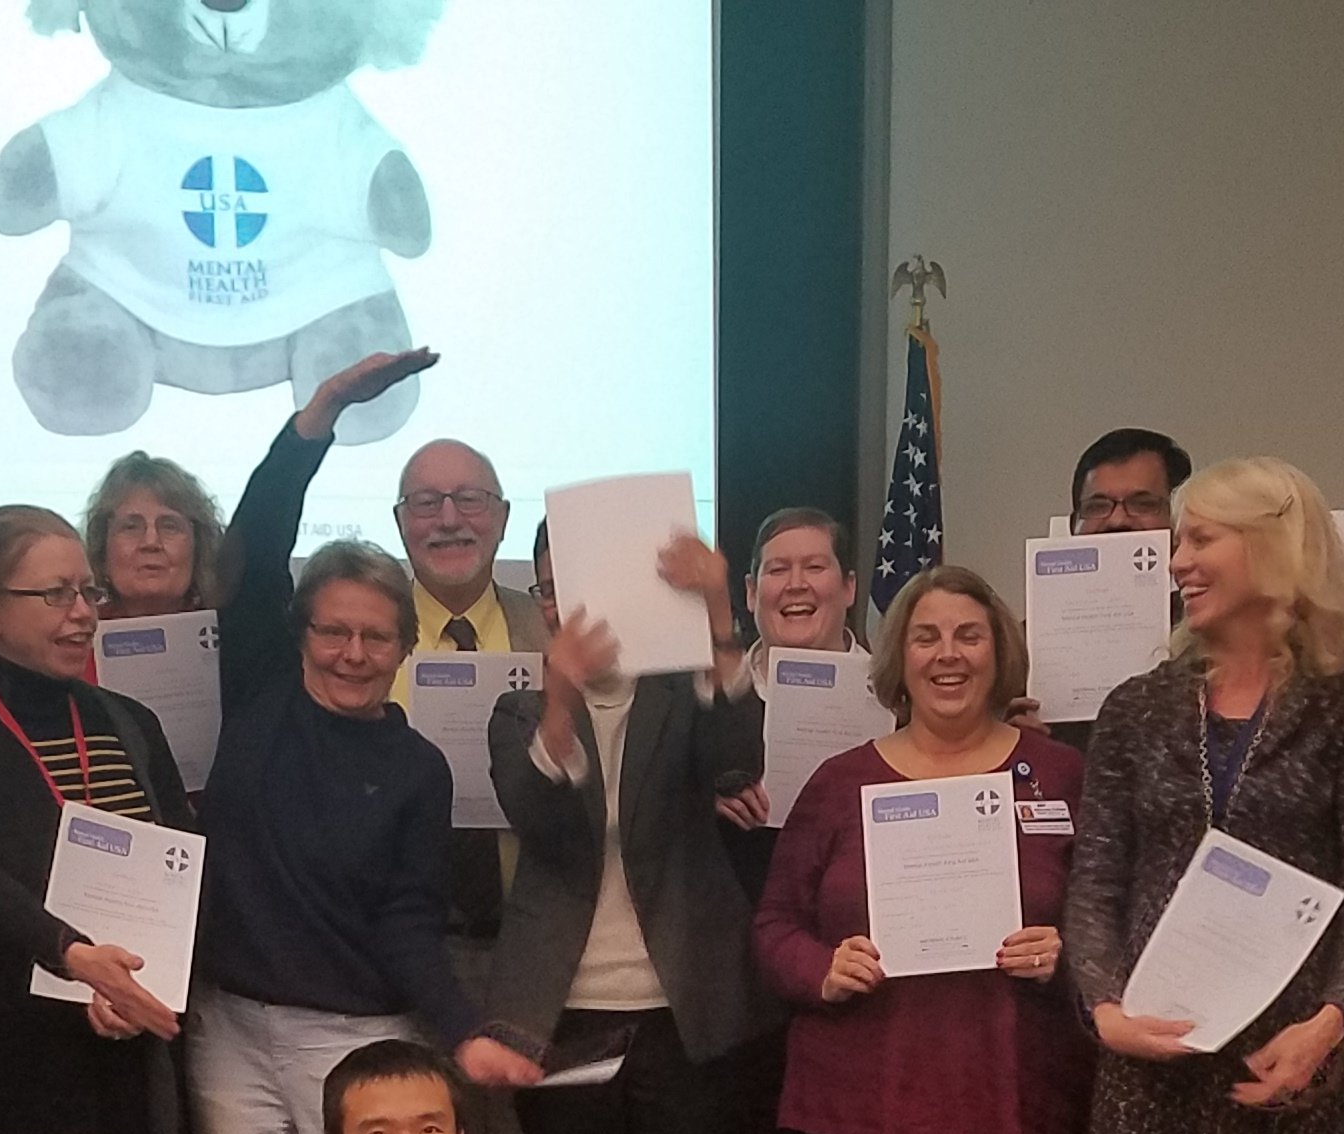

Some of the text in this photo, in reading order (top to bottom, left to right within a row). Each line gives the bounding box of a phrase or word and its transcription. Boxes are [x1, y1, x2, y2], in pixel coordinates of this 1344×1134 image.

[200, 193, 247, 211] USA
[188, 259, 265, 276] MENTAL
[189, 273, 267, 293] HEALTH
[337, 523, 363, 537] USA
